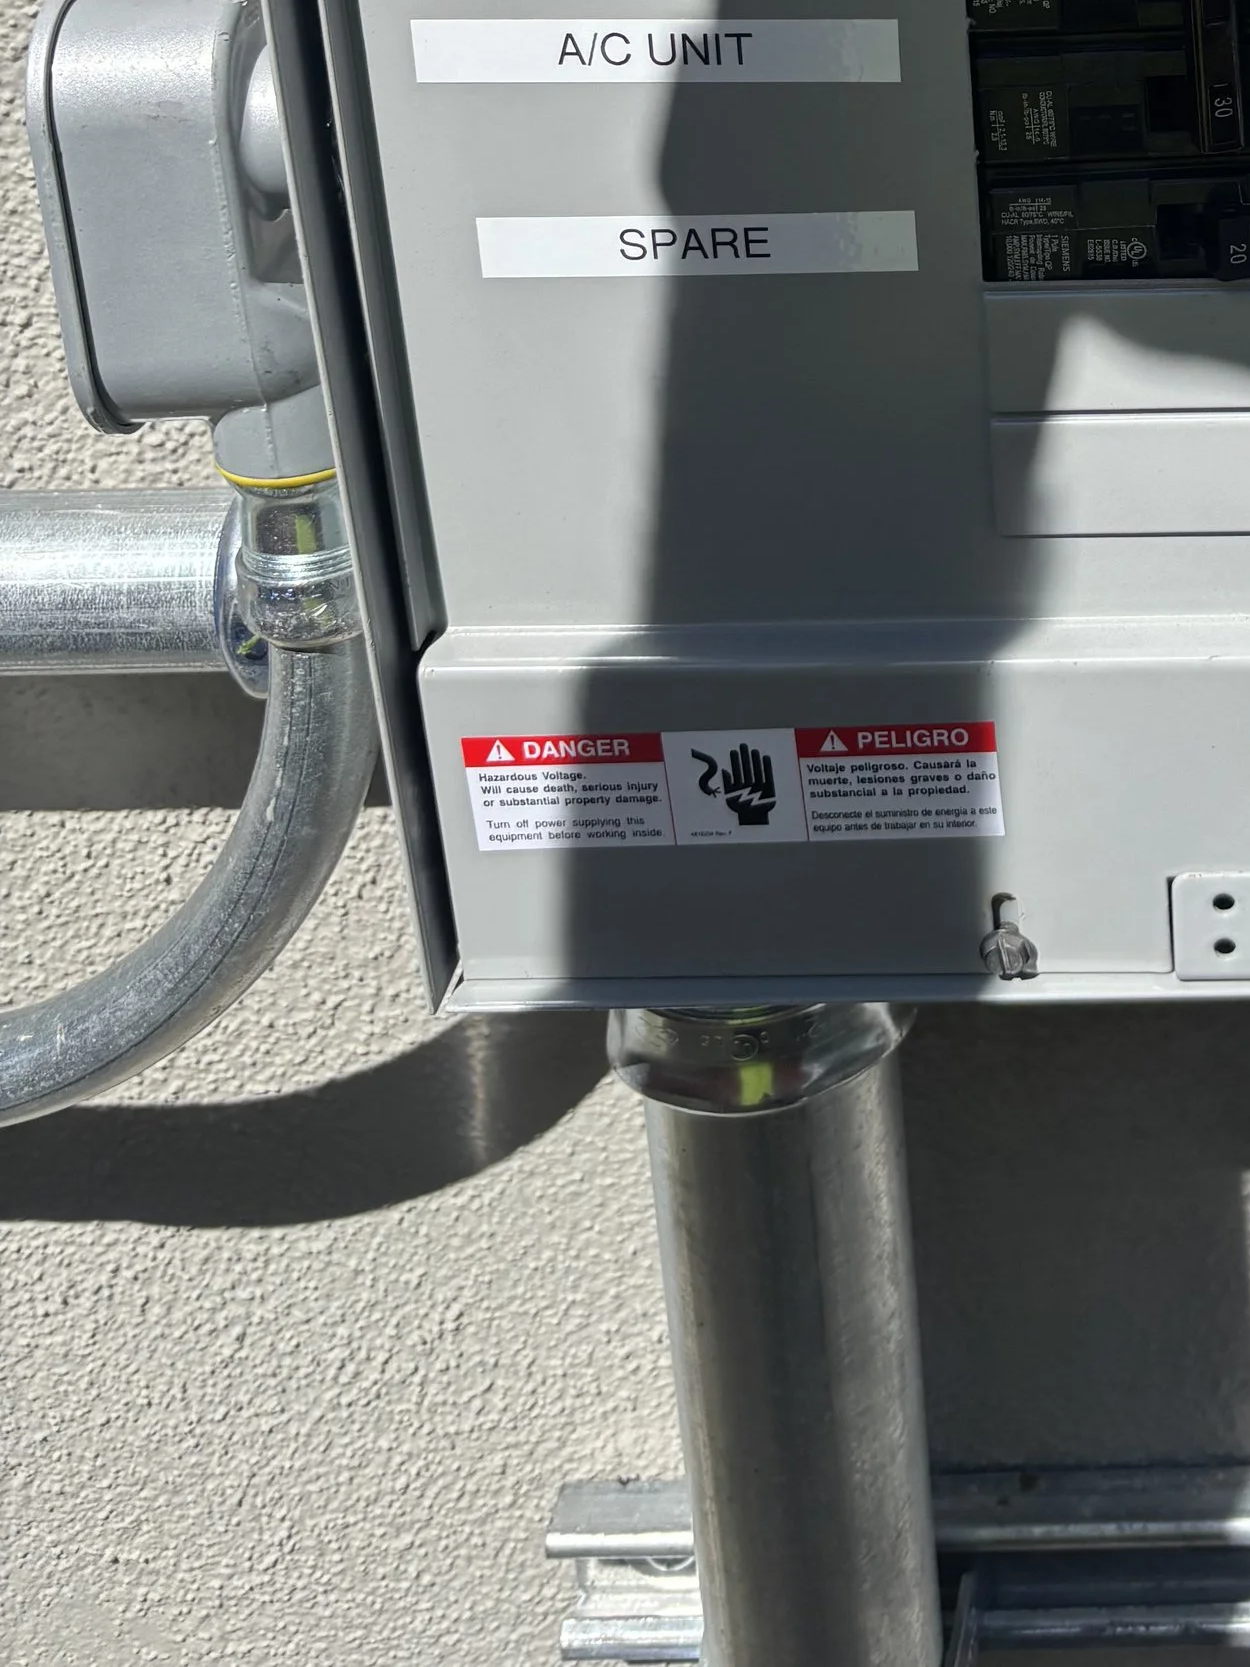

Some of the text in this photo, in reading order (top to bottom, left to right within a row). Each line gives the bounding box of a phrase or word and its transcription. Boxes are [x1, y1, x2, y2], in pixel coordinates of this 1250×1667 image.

[558, 33, 752, 66] A/C UNIT
[1214, 97, 1233, 117] 30
[620, 227, 770, 260] SPARE
[1230, 244, 1247, 263] 20
[858, 728, 970, 749] PELIGRO
[522, 739, 631, 759] DANGER
[806, 763, 846, 775] Voltaje
[966, 759, 977, 768] la
[479, 773, 538, 782] Hazardous
[857, 775, 905, 784] lesiones
[910, 774, 949, 785] graves
[967, 770, 996, 781] daño
[480, 781, 658, 795] Will cause death, serious injury
[810, 788, 876, 798] substancial
[893, 787, 903, 796] la
[483, 799, 495, 807] or
[500, 796, 560, 806] substantial
[565, 795, 611, 806] property
[812, 810, 863, 820] Desconecte
[865, 809, 873, 818] el
[875, 808, 919, 818] suministro
[921, 808, 932, 817] de
[979, 806, 997, 815] este
[486, 820, 510, 829] Turn
[535, 820, 566, 829] power
[572, 817, 621, 828] supplying
[626, 816, 645, 826] this
[813, 823, 842, 833] equipo
[845, 821, 868, 830] antes
[871, 821, 882, 830] de
[884, 820, 917, 831] trabajar
[489, 832, 543, 843] equipment
[548, 830, 580, 840] before
[587, 829, 626, 840] working
